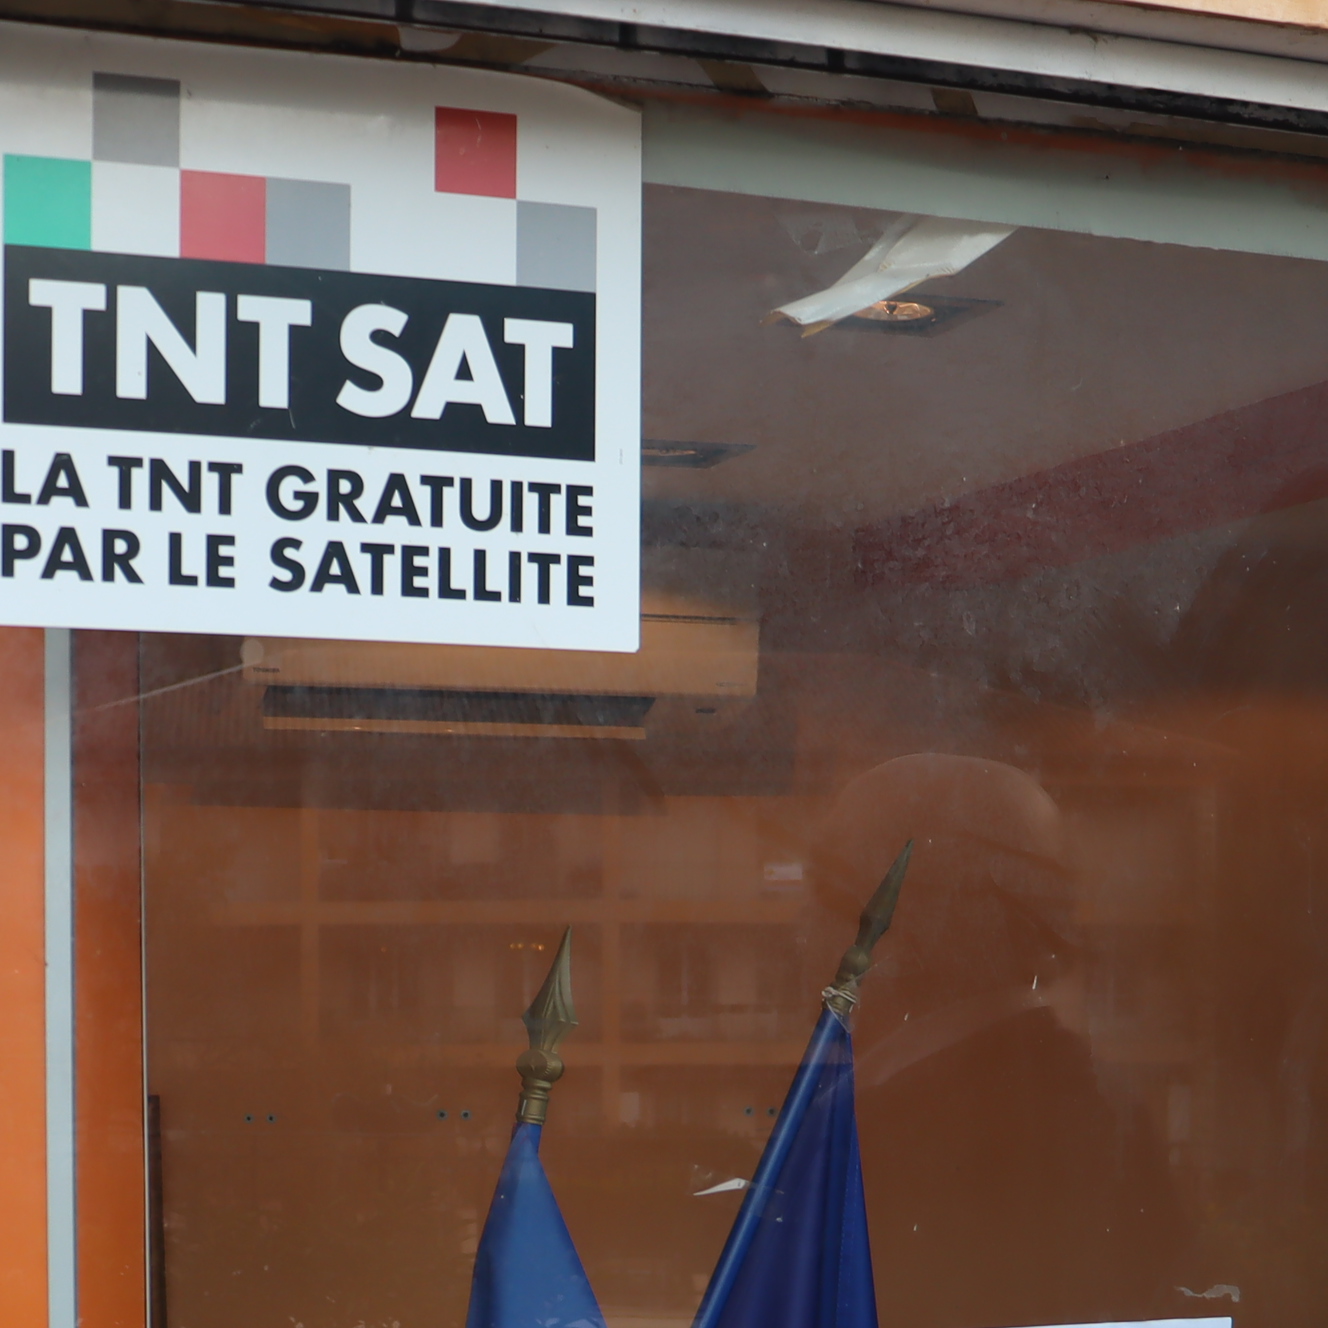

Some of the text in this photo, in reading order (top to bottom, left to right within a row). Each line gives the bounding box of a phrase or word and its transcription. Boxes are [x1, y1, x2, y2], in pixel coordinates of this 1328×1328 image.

[28, 278, 574, 428] TNT SAT
[1, 449, 594, 538] LA TNT GRATUITE
[1, 524, 595, 608] PAR LE SATELLITE
